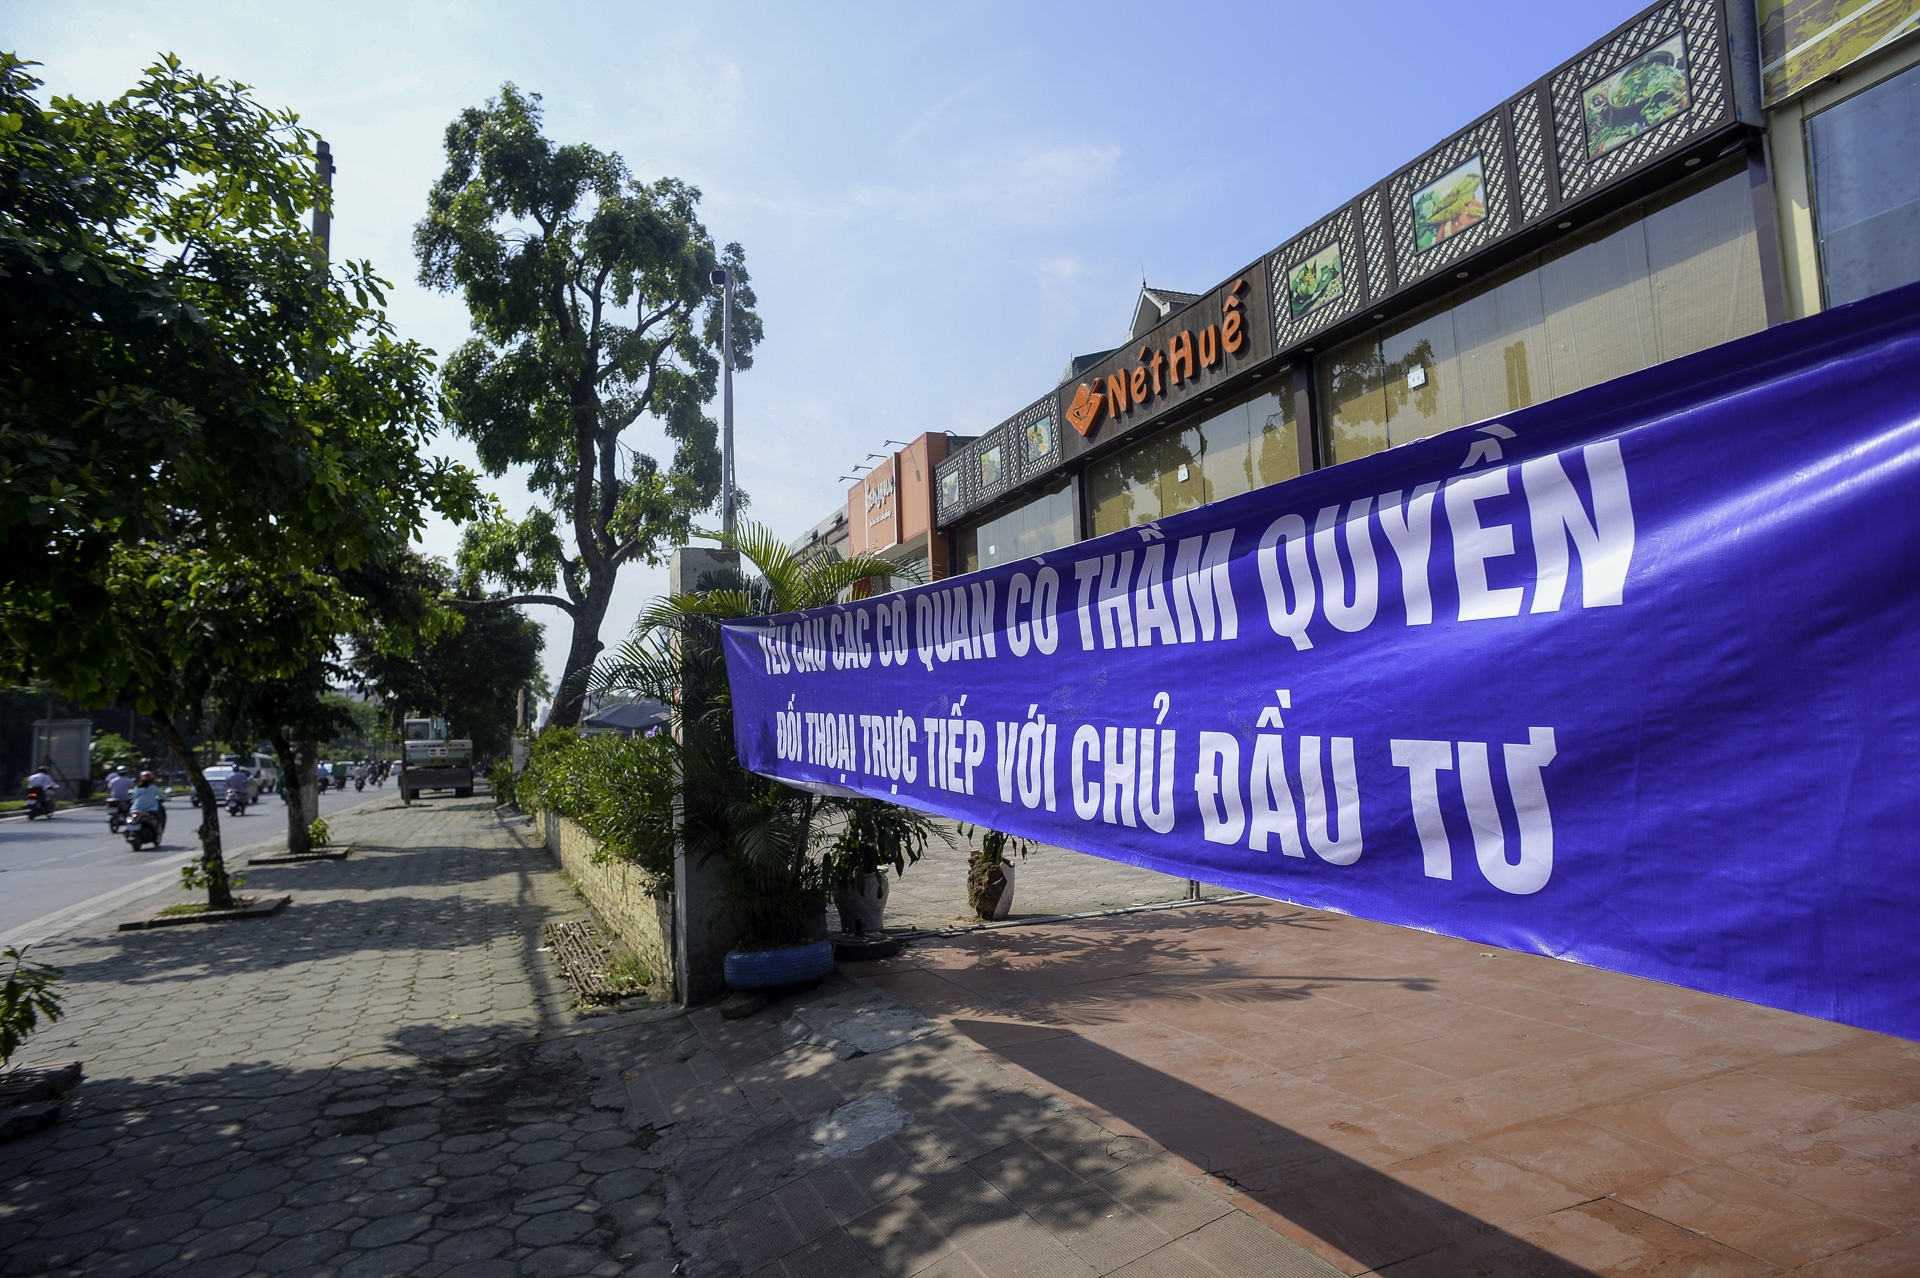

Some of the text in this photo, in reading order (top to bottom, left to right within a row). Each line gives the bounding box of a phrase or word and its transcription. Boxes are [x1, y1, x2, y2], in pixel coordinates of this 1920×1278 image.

[758, 618, 791, 675] YÊU
[915, 579, 997, 672] QUAN
[1257, 423, 1636, 650] QUYỀN
[776, 689, 1558, 896] ĐỐI THOẠI TRỰC TIẾP VỚI CHỦ ĐẦU TƯ
